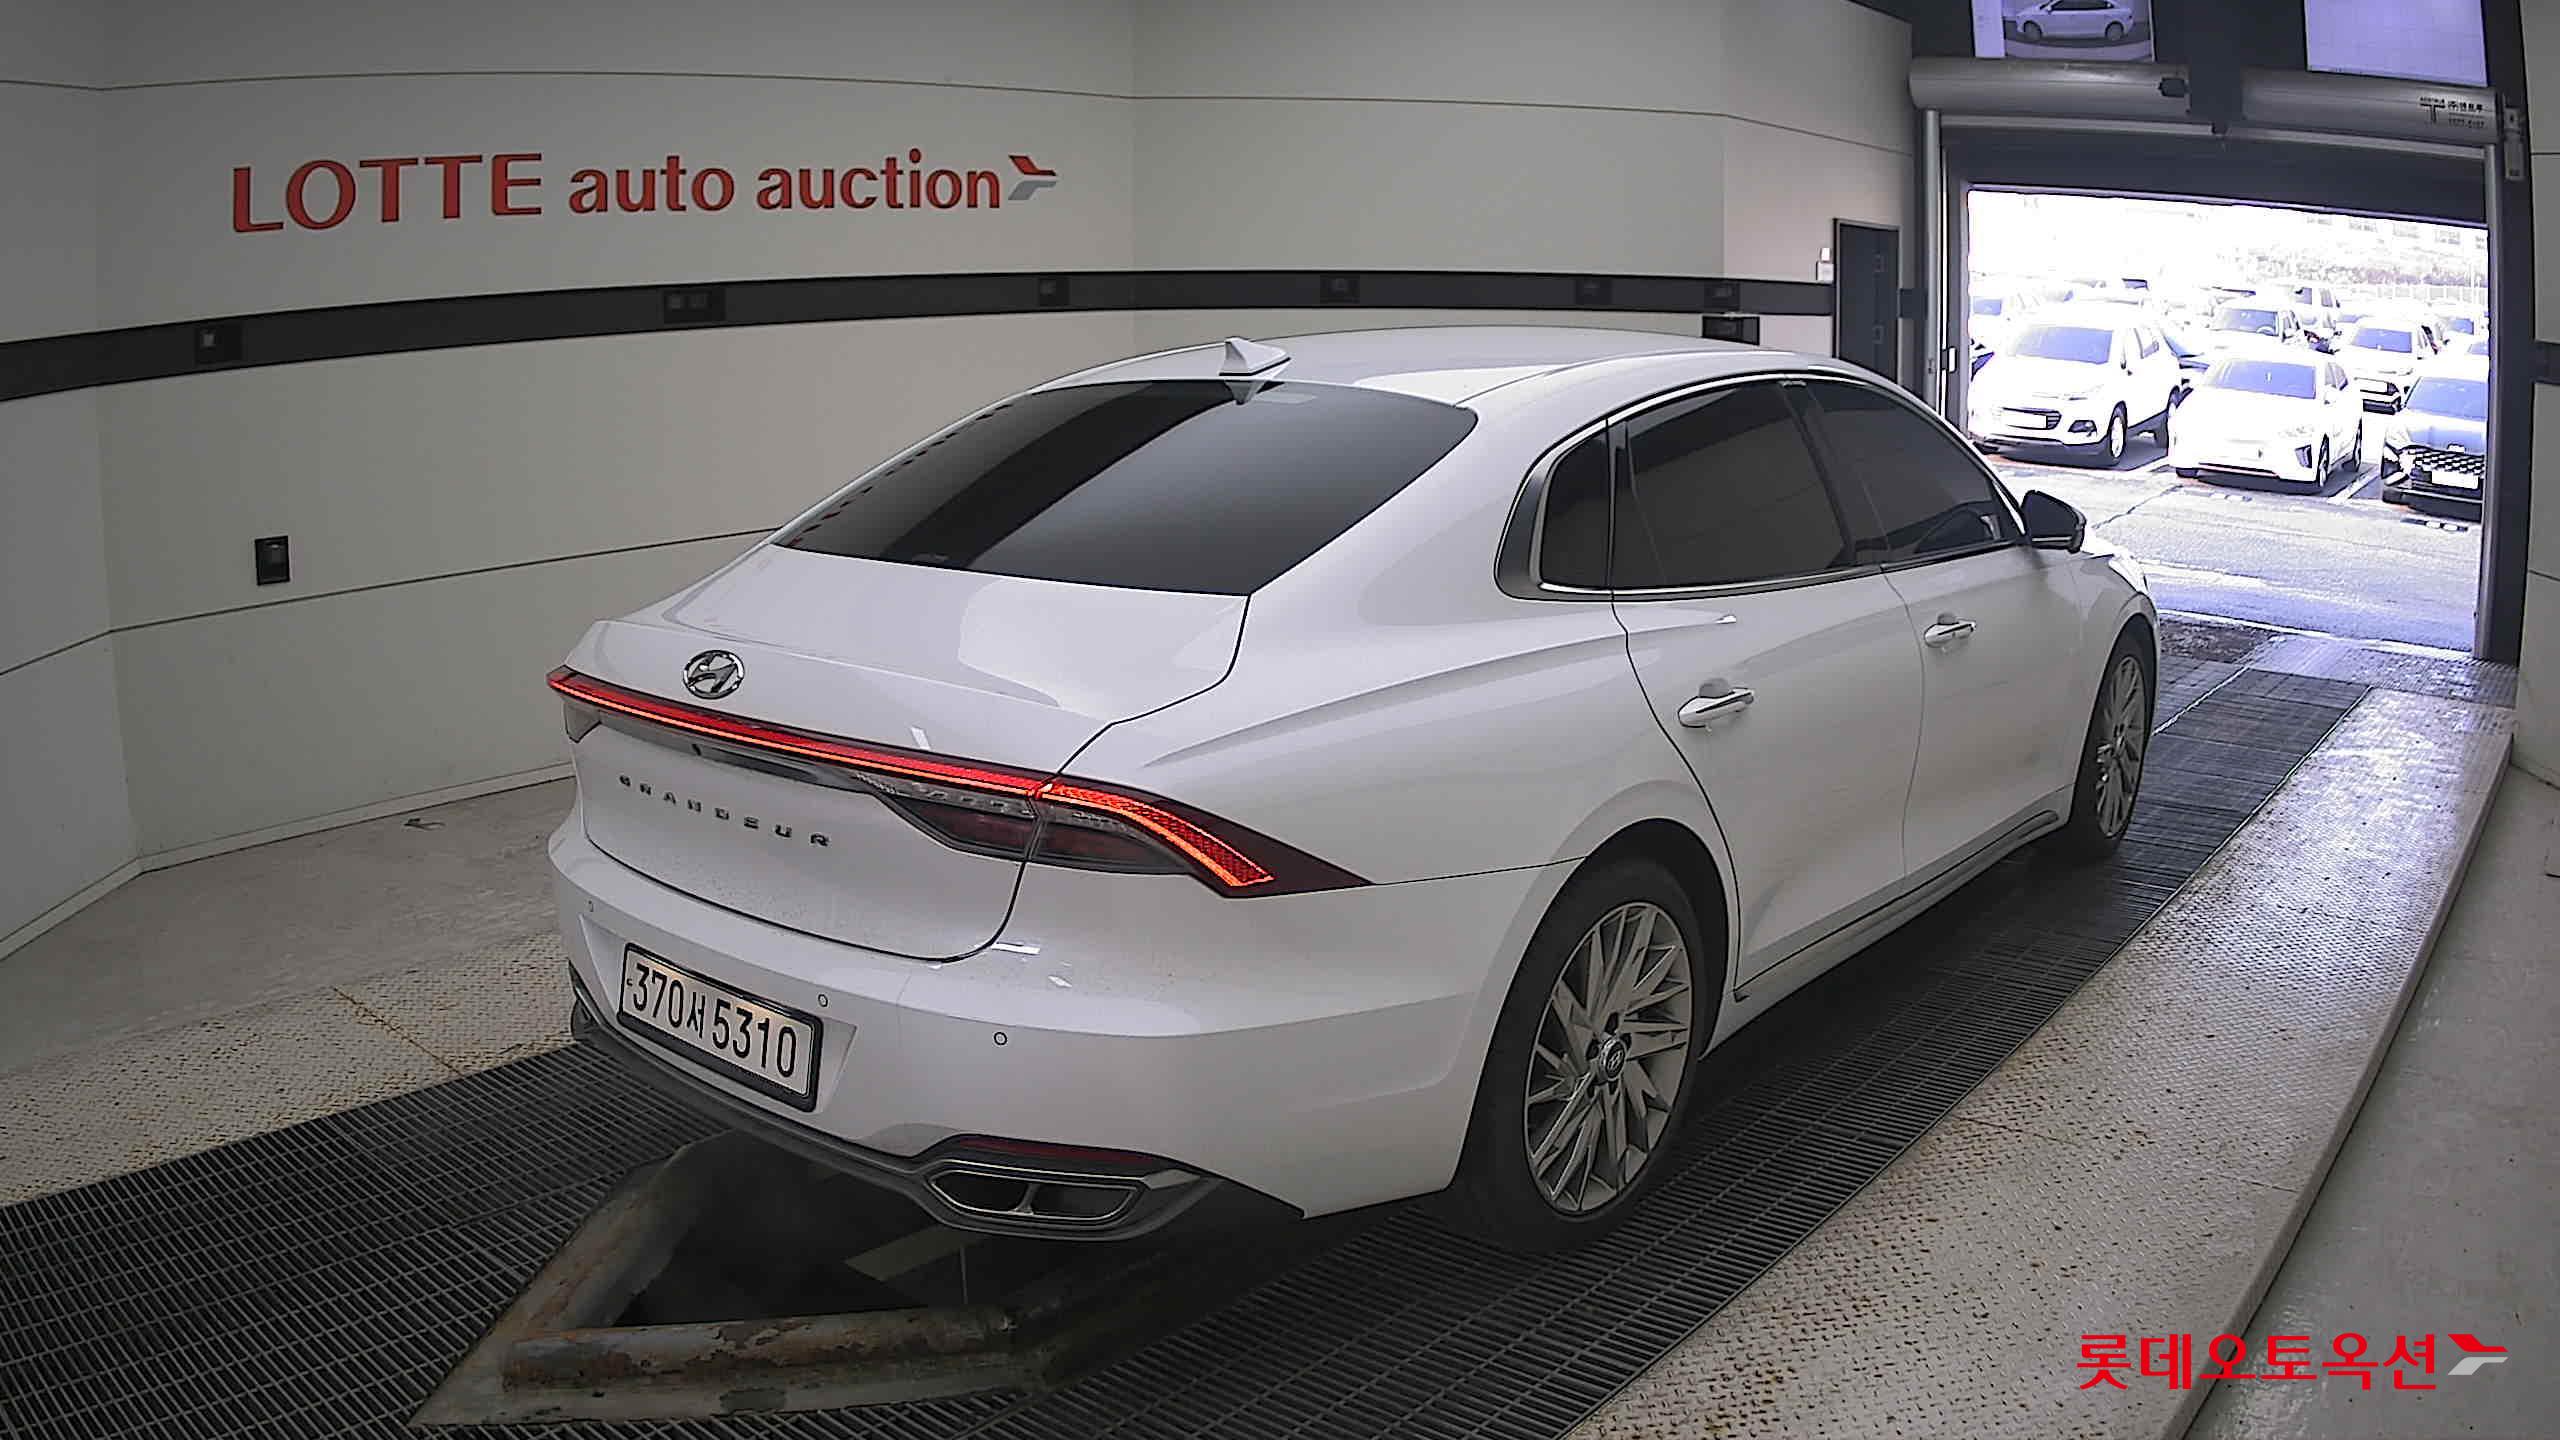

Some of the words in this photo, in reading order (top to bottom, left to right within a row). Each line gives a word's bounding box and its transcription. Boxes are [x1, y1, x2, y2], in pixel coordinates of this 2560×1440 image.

[233, 153, 540, 233] LOTTE
[569, 156, 734, 213] auto
[757, 150, 1000, 211] auction
[619, 774, 830, 847] GRANDEUR
[711, 998, 798, 1078] 5310
